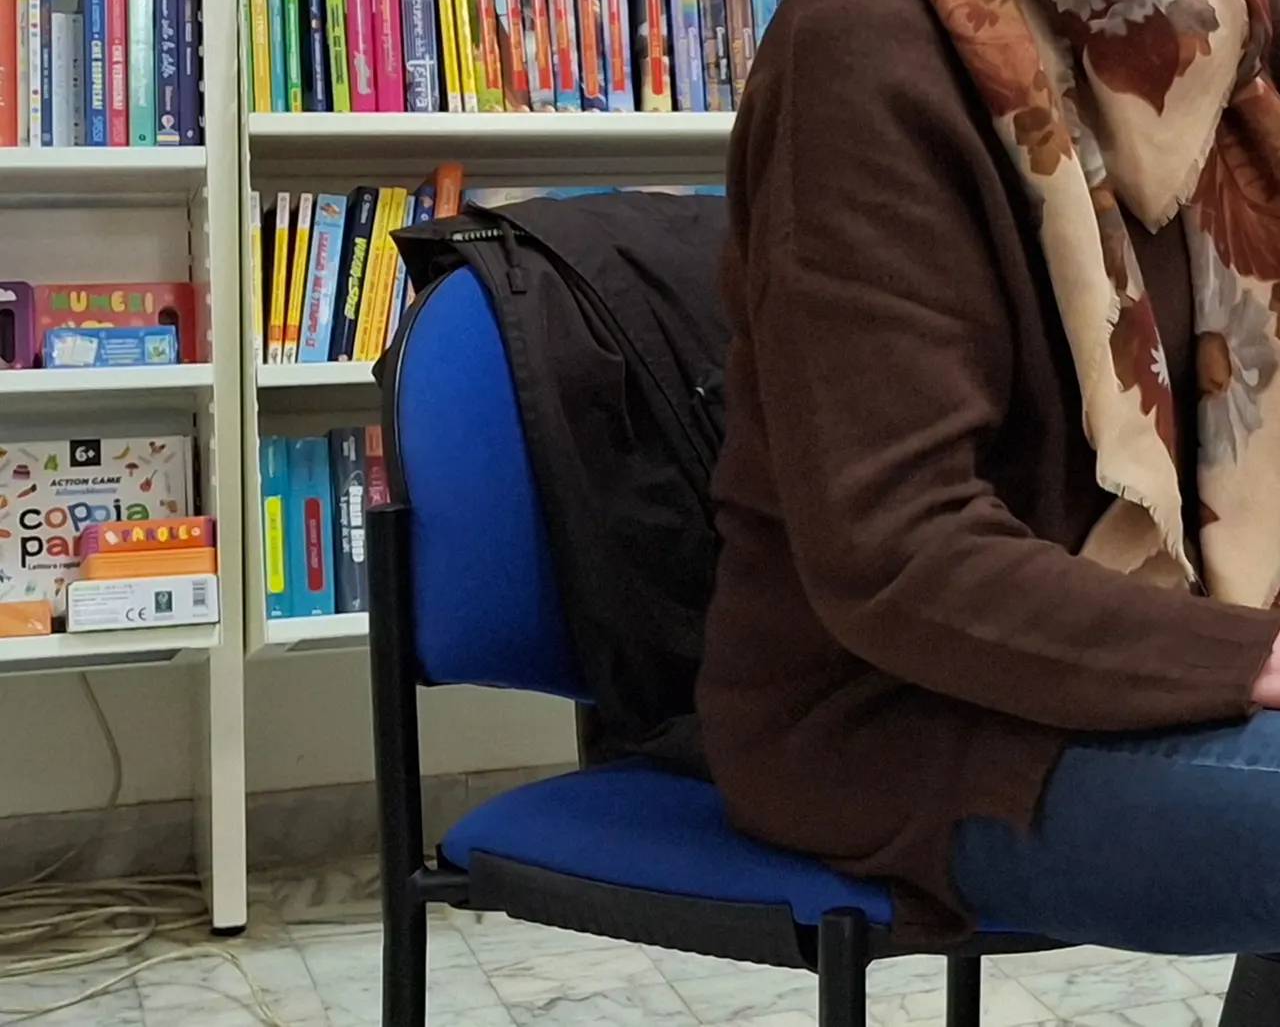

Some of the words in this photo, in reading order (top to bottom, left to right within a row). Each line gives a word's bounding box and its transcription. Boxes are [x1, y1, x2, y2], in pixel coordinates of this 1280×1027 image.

[91, 40, 102, 59] CHE
[112, 45, 123, 62] CHE
[51, 290, 154, 314] NUMERI
[74, 443, 96, 463] 6+
[50, 477, 89, 488] ACTION
[92, 475, 122, 486] GAME
[121, 524, 189, 545] PAROLE
